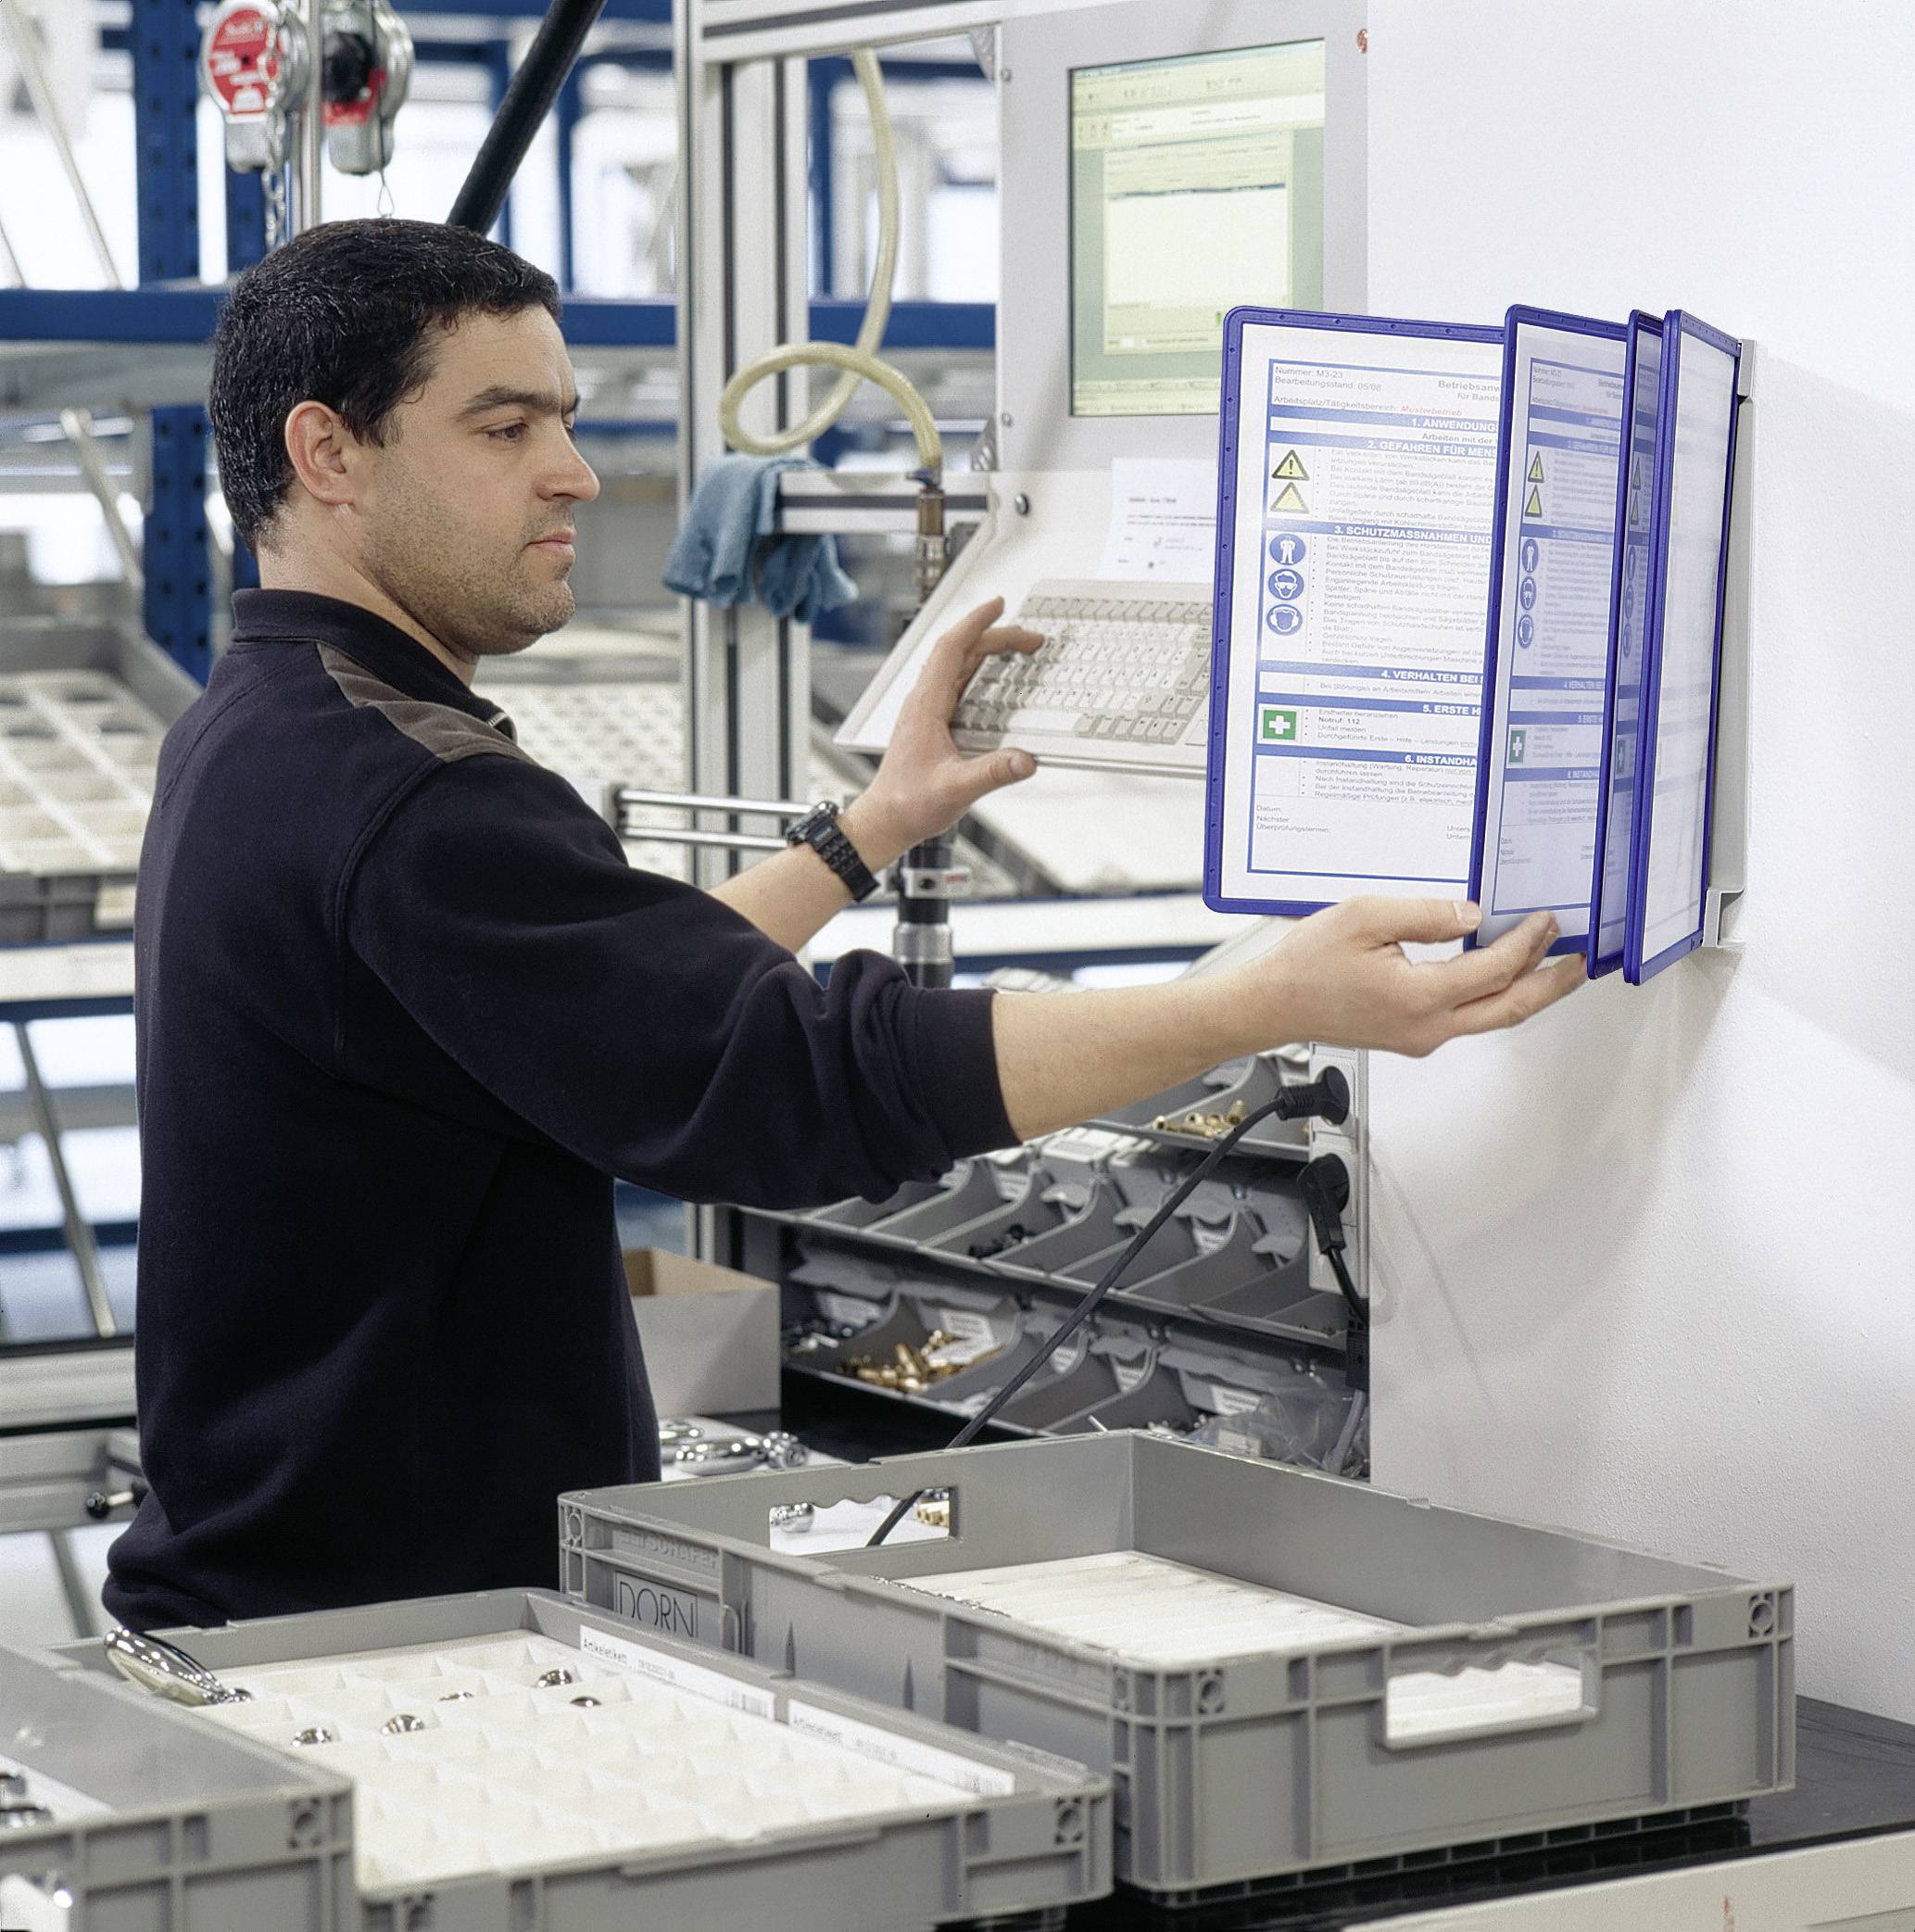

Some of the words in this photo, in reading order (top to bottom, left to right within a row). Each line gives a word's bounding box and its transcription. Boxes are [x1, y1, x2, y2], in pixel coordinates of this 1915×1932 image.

[1317, 370, 1343, 378] M3-23
[1357, 383, 1382, 392] 05/08
[1400, 405, 1463, 416] Musterbetrieb
[1411, 418, 1421, 426] 1.
[1421, 433, 1459, 442] Arbeiten
[1367, 441, 1377, 449] 2.
[1380, 442, 1440, 453] GEFAHREN
[1443, 445, 1467, 455] FÜR
[1346, 527, 1468, 542] SCHUTZMASSNAHMEN
[1469, 534, 1492, 544] UND
[1381, 670, 1391, 678] 4.
[1393, 671, 1458, 682] VERHALTEN
[1460, 674, 1479, 684] BEI
[1422, 705, 1432, 713] 5.
[1434, 705, 1469, 715] ERSTE
[1405, 754, 1414, 763] 6.
[1416, 755, 1477, 765] INSTANDHA
[620, 1581, 694, 1637] DORN
